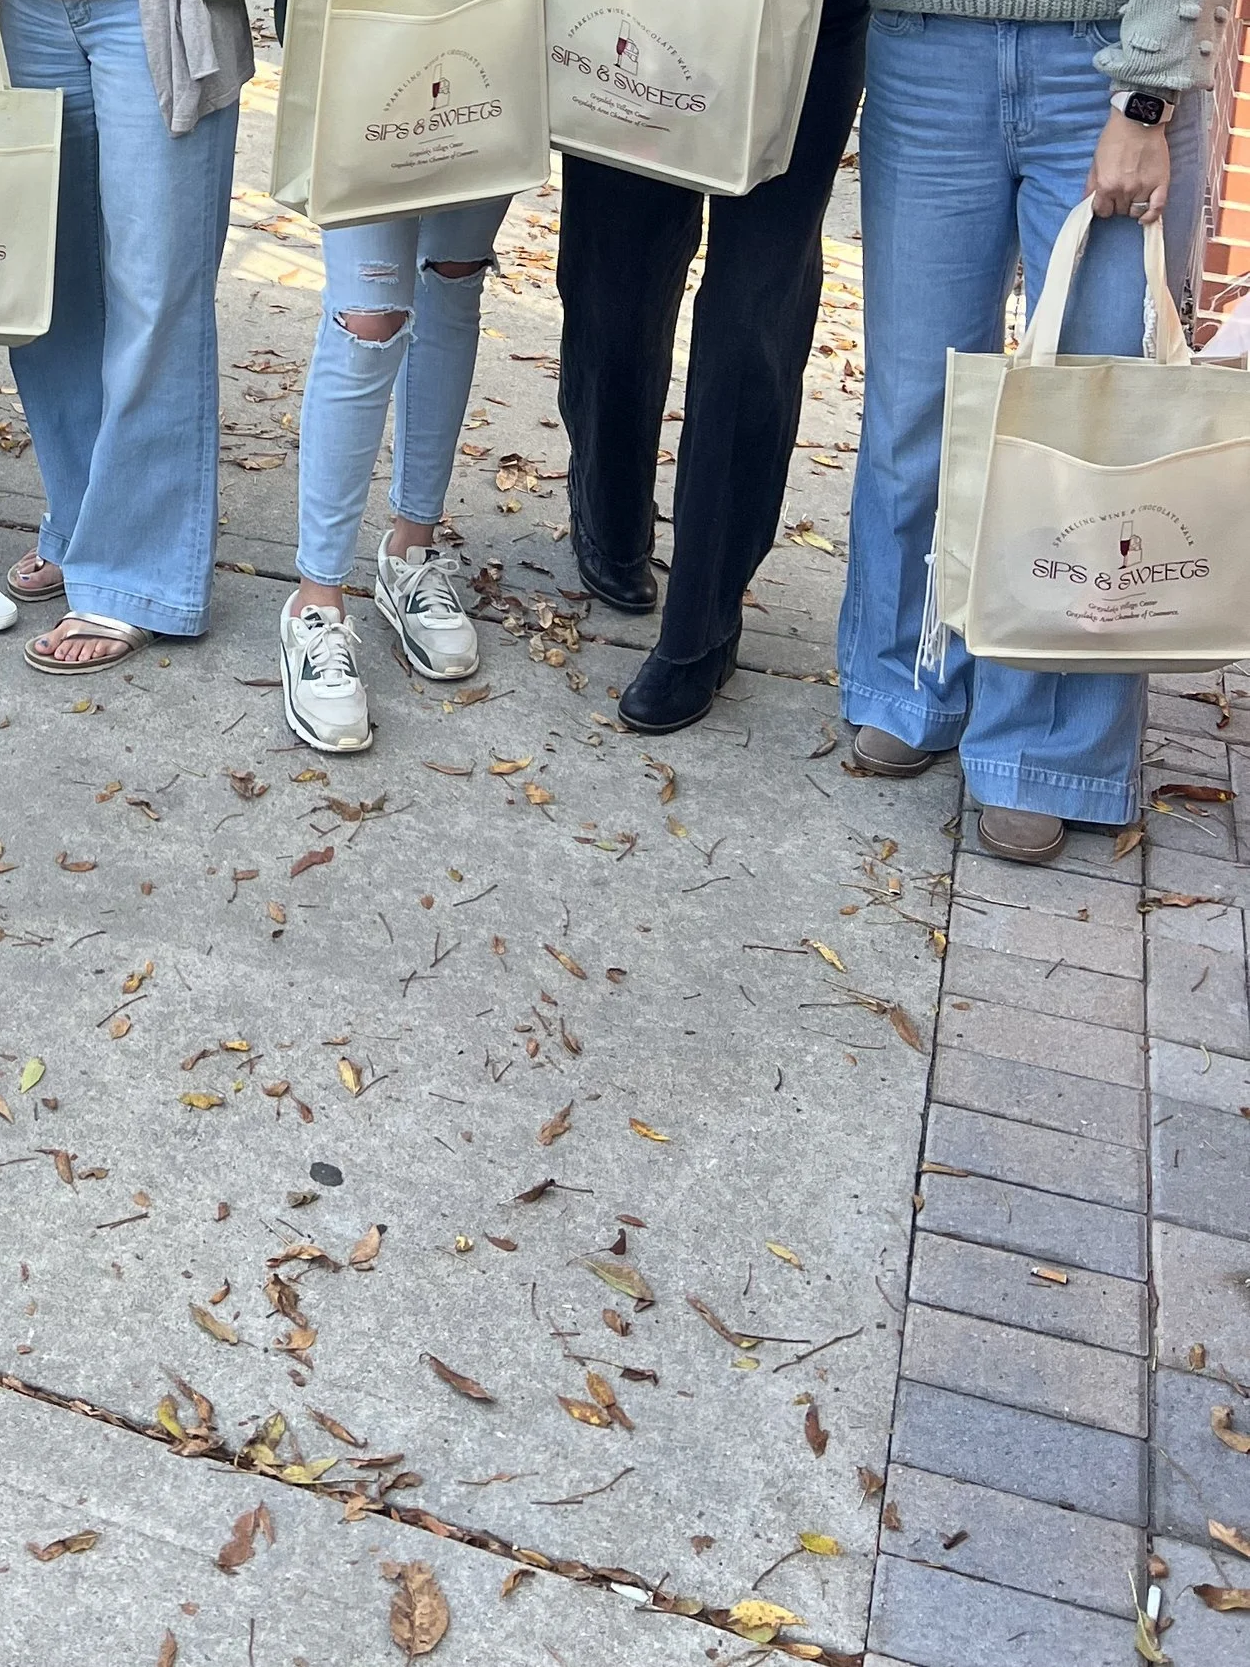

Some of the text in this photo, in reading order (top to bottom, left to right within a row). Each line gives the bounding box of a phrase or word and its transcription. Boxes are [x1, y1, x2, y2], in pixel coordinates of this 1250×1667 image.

[551, 45, 706, 112] SIPS & SWEETS
[365, 99, 502, 142] SIPS & SWEETS
[1052, 517, 1096, 548] SPARKLING
[1099, 510, 1126, 522] WINE
[1138, 504, 1179, 524] CHOCOLATE
[1180, 523, 1195, 547] WALK
[1032, 558, 1210, 591] SIPS & SWEETS
